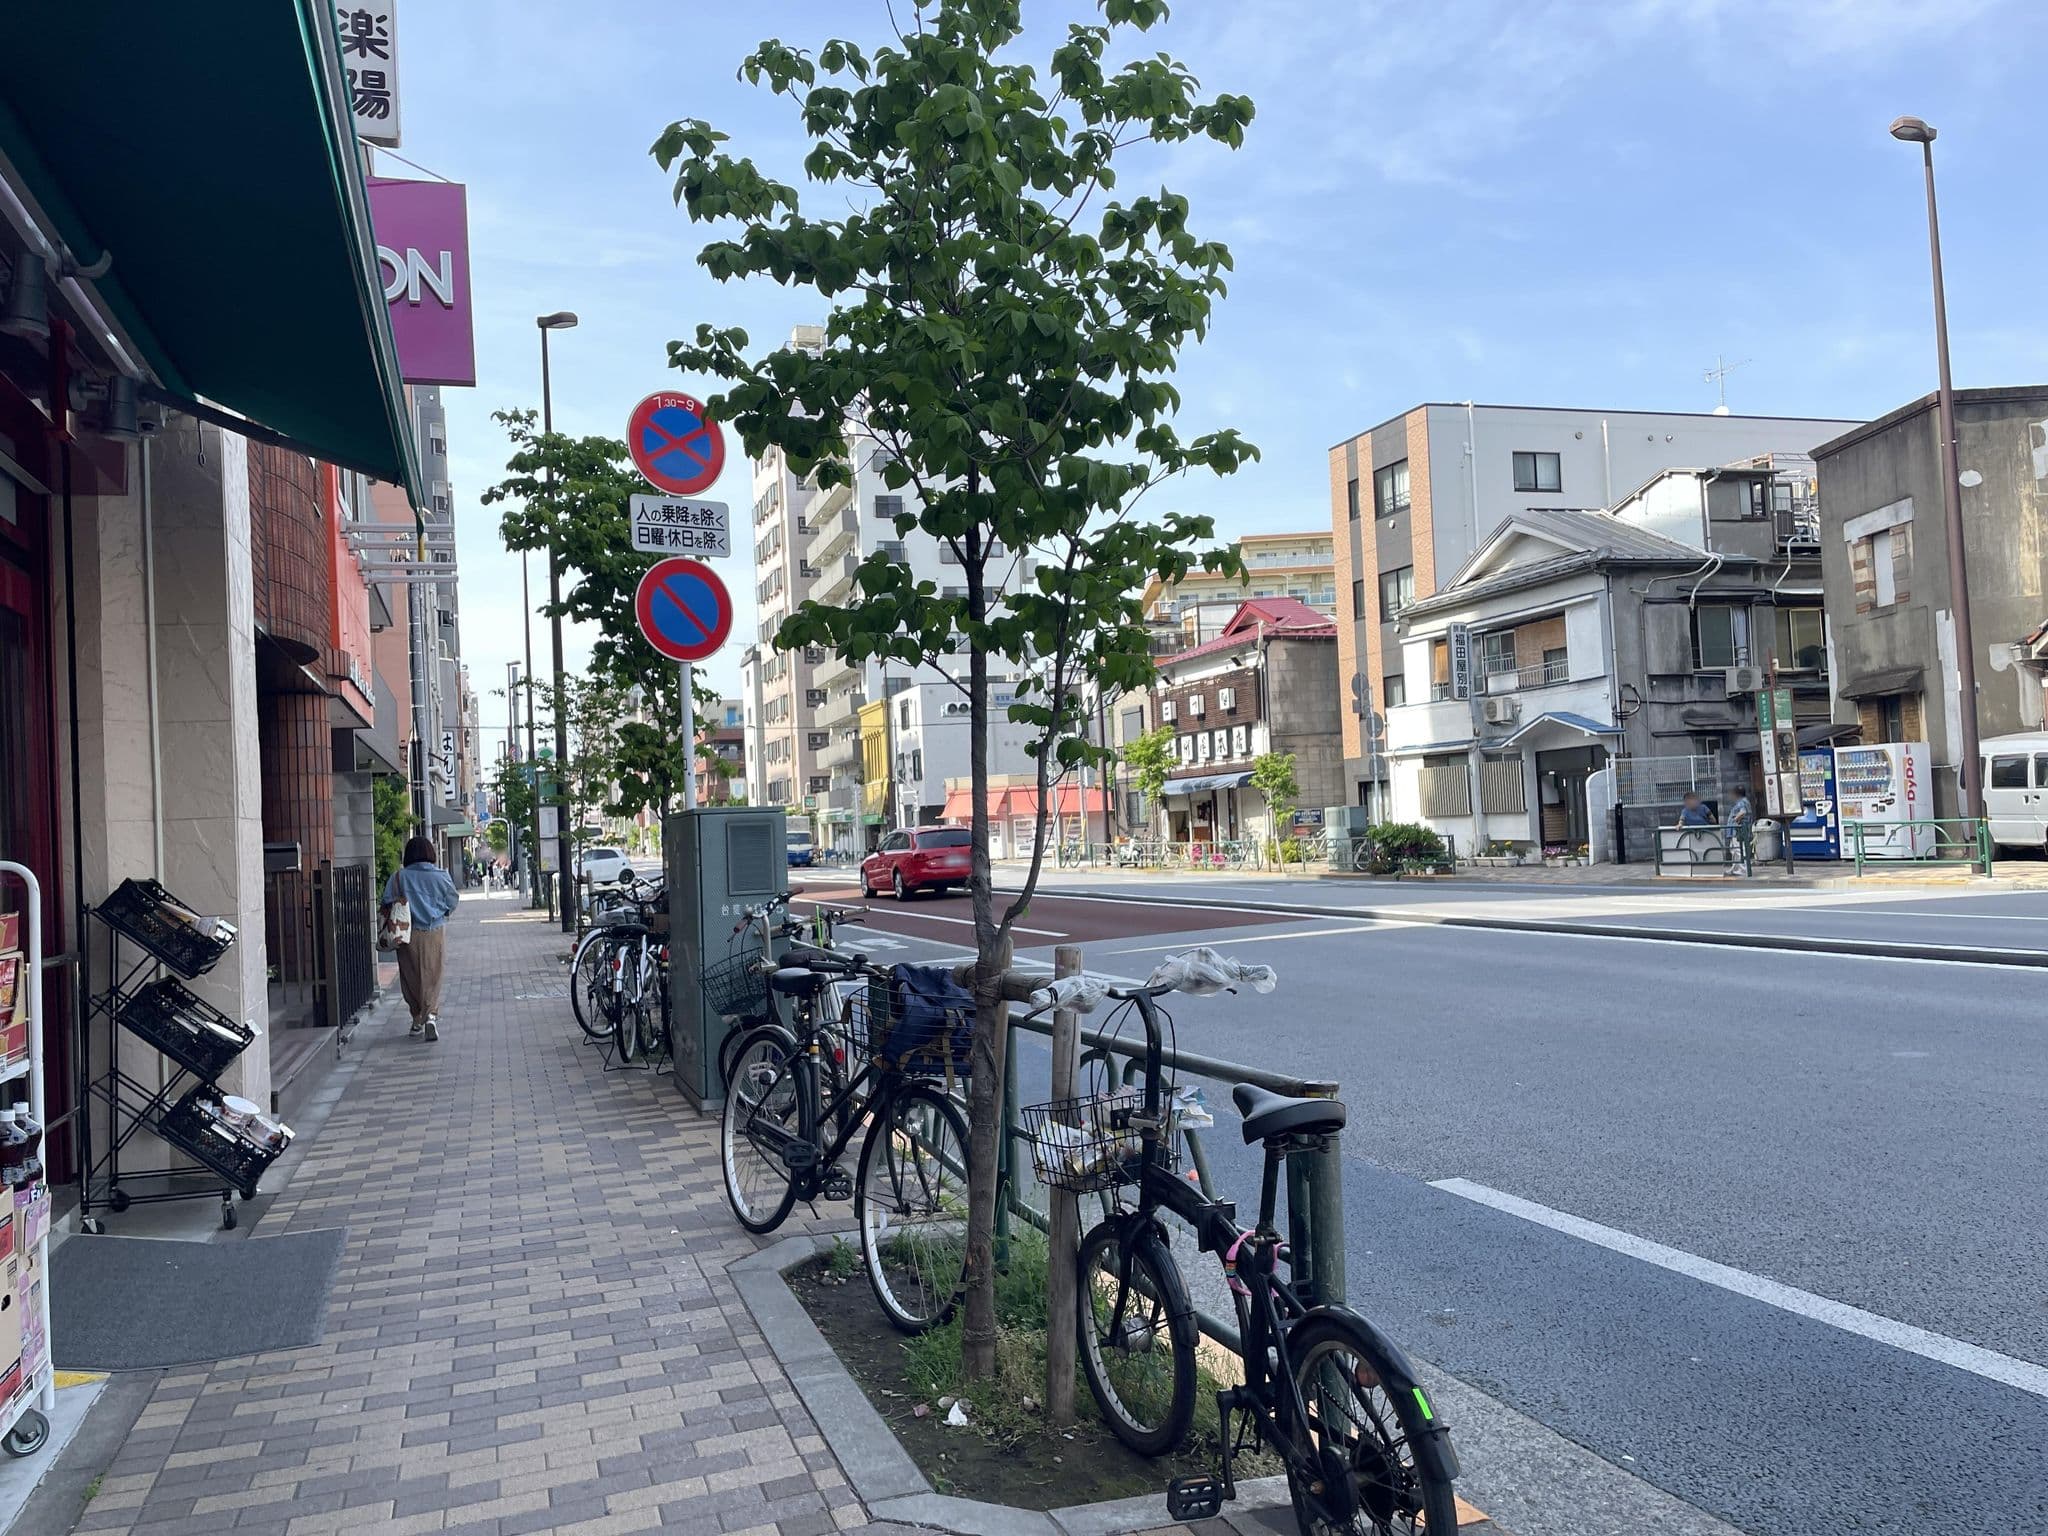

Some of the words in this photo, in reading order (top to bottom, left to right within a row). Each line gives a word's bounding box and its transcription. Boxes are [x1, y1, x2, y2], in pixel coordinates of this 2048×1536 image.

[337, 8, 391, 120] 楽陽
[636, 502, 725, 528] 人の乗降を除く
[1455, 633, 1468, 698] 福田屋別館
